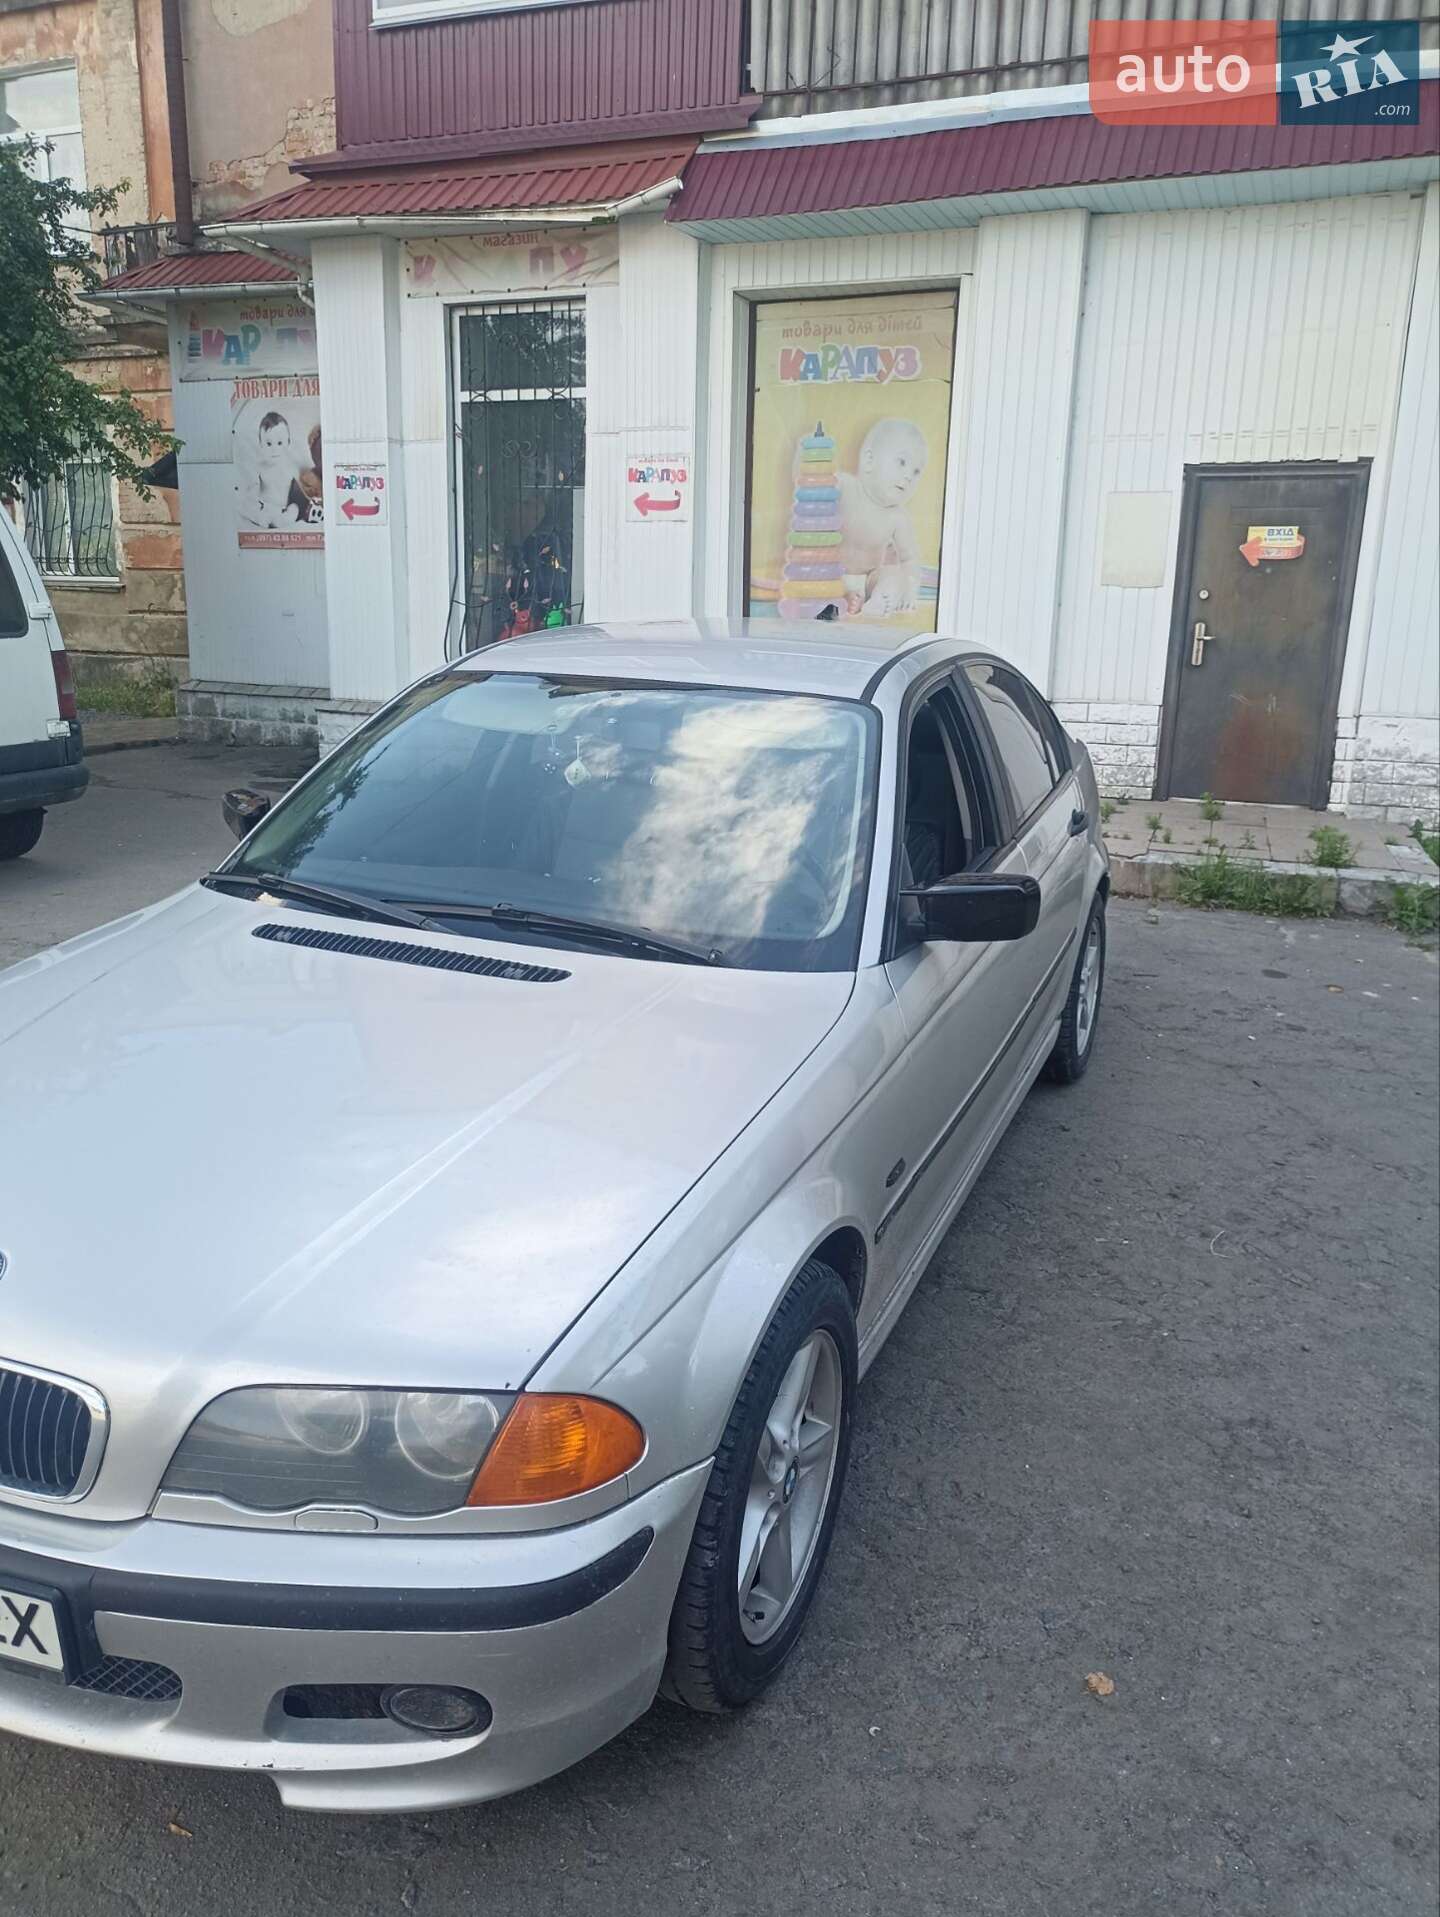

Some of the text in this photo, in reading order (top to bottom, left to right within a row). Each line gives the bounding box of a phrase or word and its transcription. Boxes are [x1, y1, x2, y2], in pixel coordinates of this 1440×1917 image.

[482, 232, 539, 248] магазин
[240, 306, 285, 327] товари
[287, 304, 307, 318] для
[782, 313, 923, 343] товари для дітей
[779, 343, 921, 385] КАРАПУЗ
[233, 377, 320, 400] ТОВАРИ ДЛЯ
[336, 474, 385, 491] КАРАПУЗ
[627, 467, 687, 484] КАРАПУЗ
[1267, 527, 1295, 537] ВХІД
[0, 1595, 49, 1655] X
